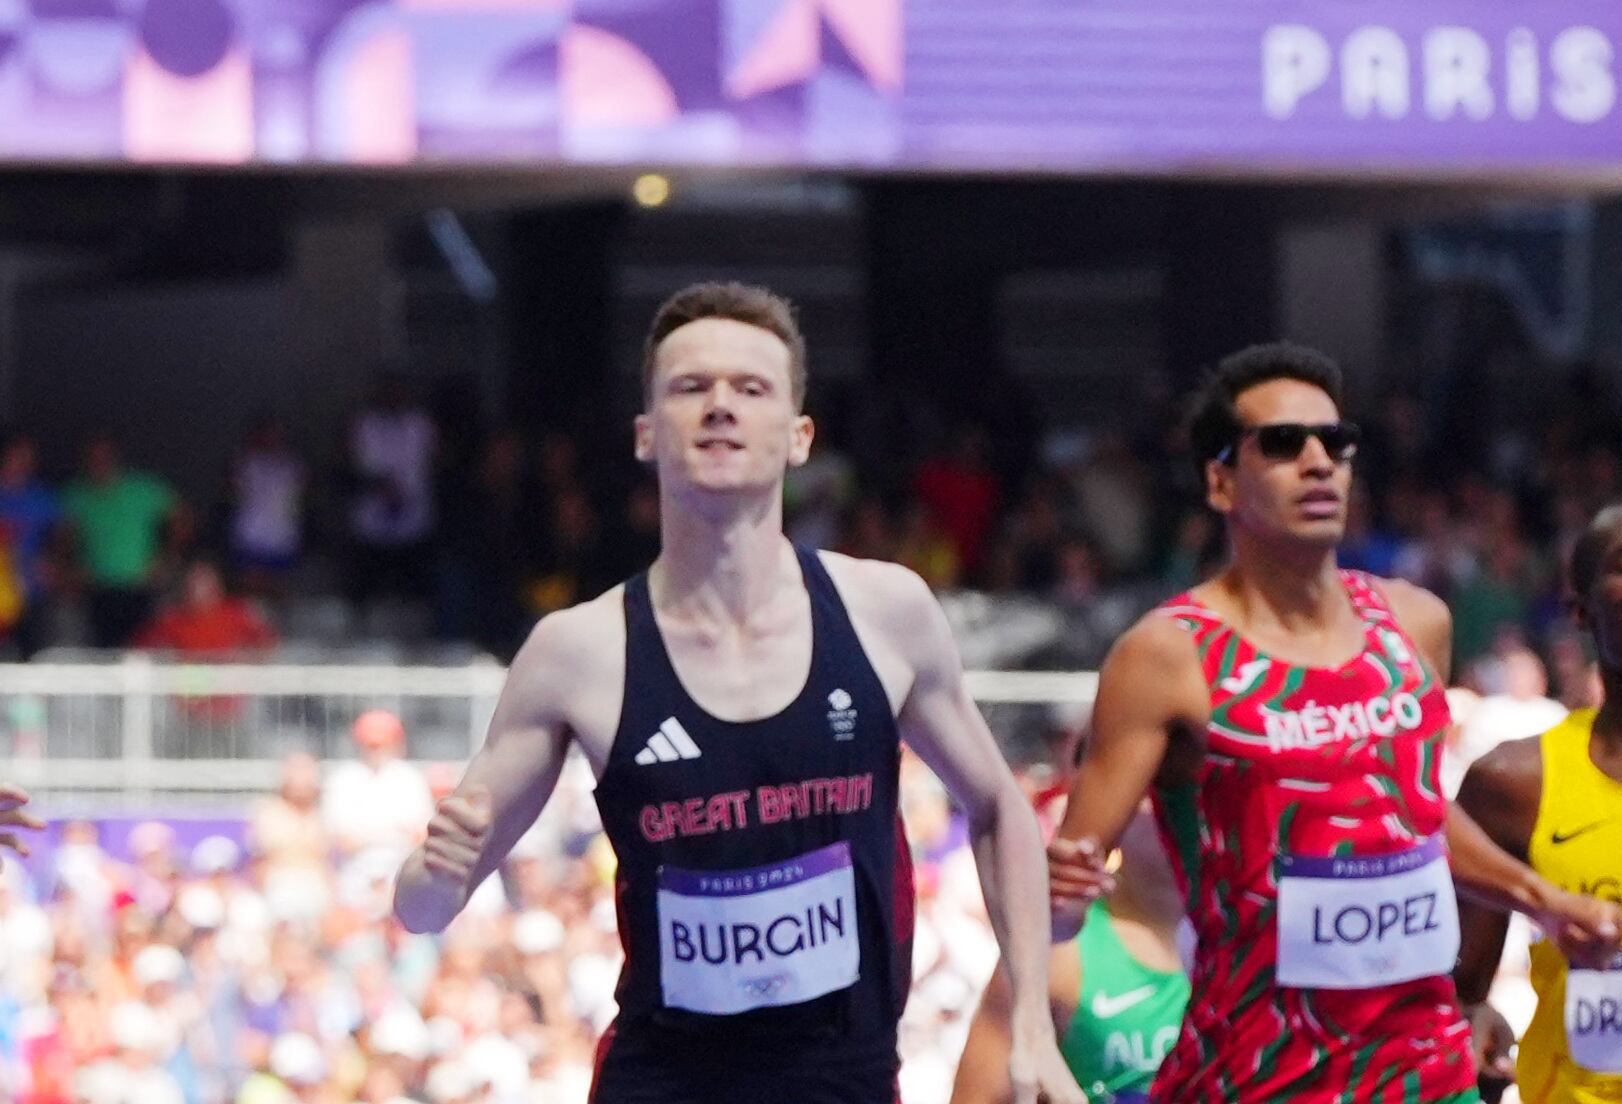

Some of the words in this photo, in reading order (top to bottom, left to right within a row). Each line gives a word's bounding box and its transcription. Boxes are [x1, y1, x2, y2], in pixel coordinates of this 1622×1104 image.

[1261, 24, 1616, 122] PARIS
[1265, 692, 1422, 753] MÉXICO
[639, 789, 750, 842] GREAT
[757, 773, 873, 825] BRITAIN
[671, 897, 846, 966] BURGIN
[1312, 891, 1440, 946] LOPEZ
